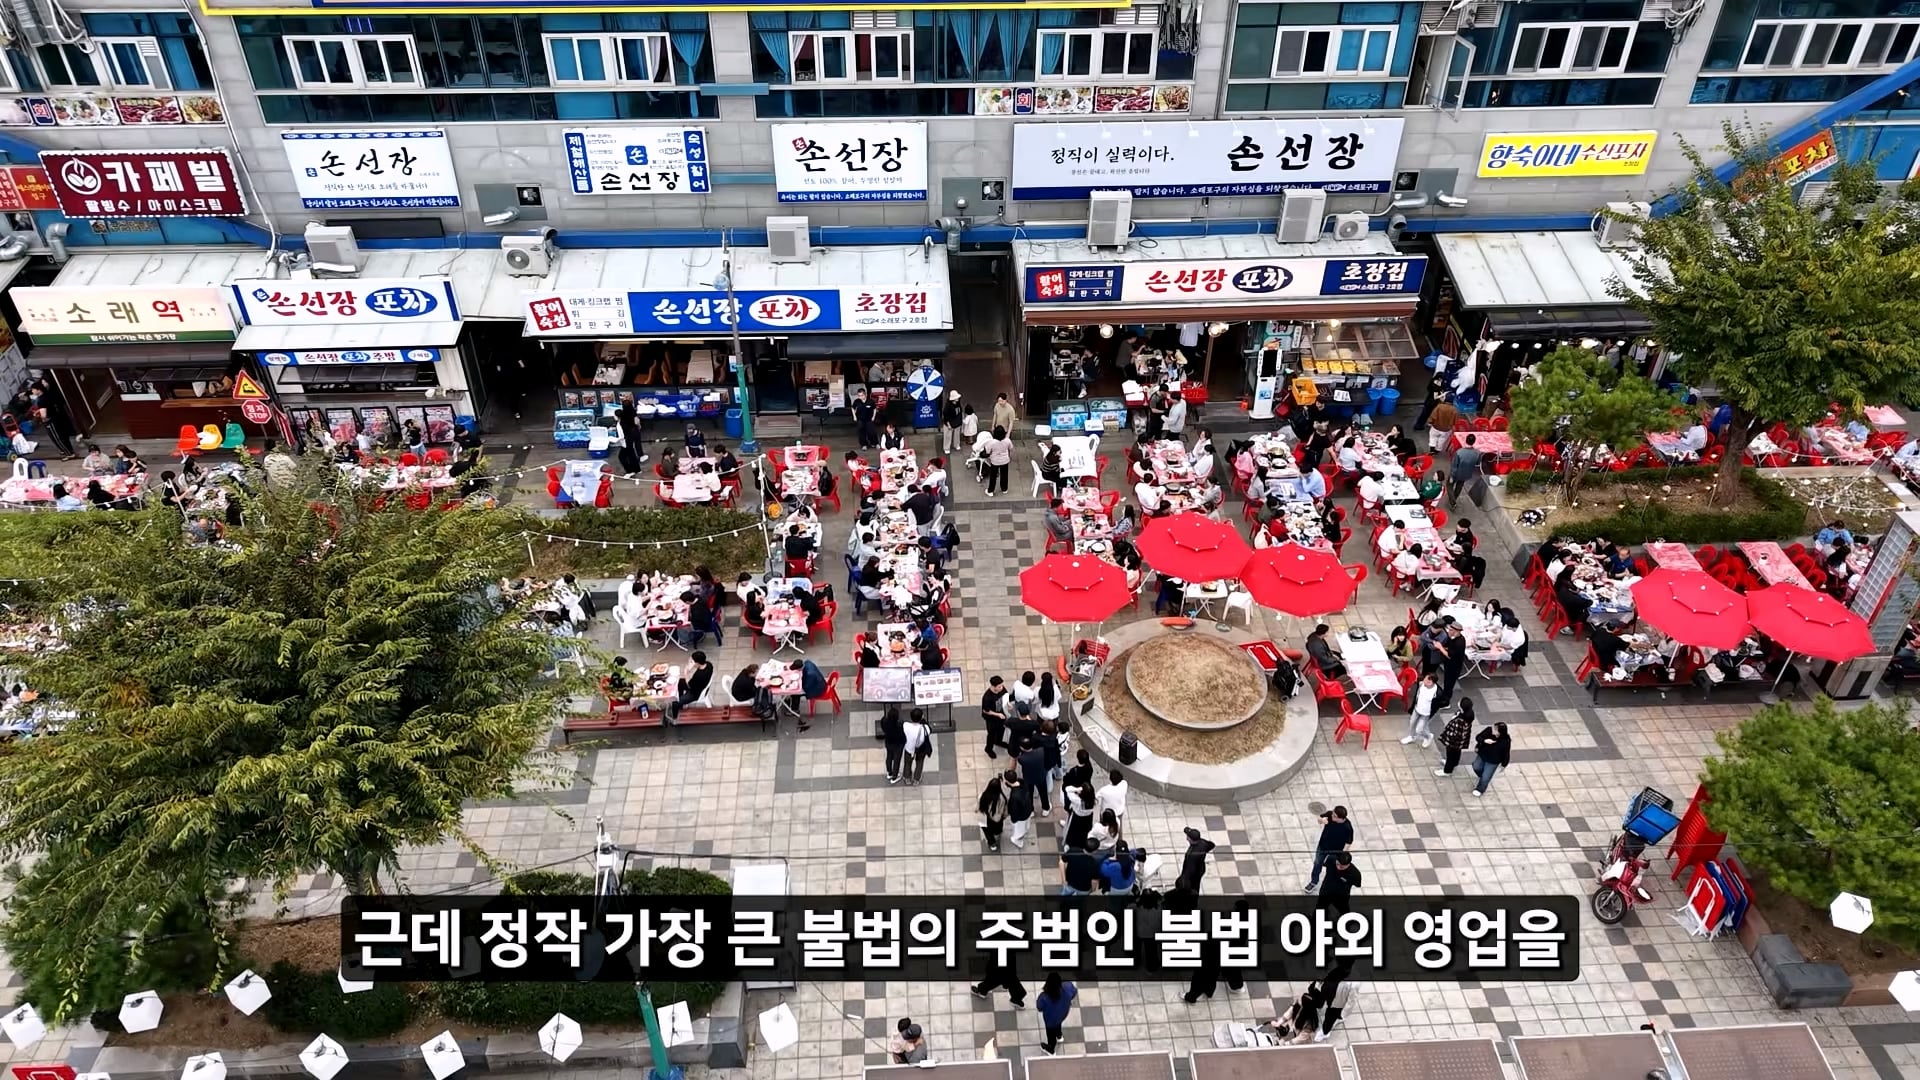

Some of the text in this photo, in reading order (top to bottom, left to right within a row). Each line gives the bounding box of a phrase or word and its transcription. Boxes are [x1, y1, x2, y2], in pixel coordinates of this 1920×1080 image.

[33, 103, 49, 118] 회
[1018, 92, 1031, 109] 회
[629, 147, 644, 163] 손
[687, 133, 702, 159] 숙성
[795, 137, 909, 172] 손선장
[1051, 145, 1175, 164] 정직이 실력이다.
[1227, 133, 1364, 172] 손선장
[1487, 143, 1648, 169] 향숙이네 수산포차
[320, 147, 417, 176] 손선장
[569, 135, 589, 191] 제철해산물
[102, 160, 227, 193] 카페빌
[600, 171, 680, 191] 손선장
[690, 164, 705, 190] 활어
[1134, 188, 1150, 196] 팔지
[1152, 186, 1187, 196] 않습니다.
[1189, 185, 1229, 194] 소래포구의
[1231, 184, 1263, 193] 자부심을
[84, 200, 131, 213] 팔빙수
[147, 198, 223, 211] 아이스크림
[1040, 271, 1063, 285] 활어
[1145, 268, 1288, 293] 손선장 포차
[1341, 262, 1408, 282] 초장집
[1041, 283, 1063, 297] 숙성
[66, 300, 184, 324] 소래역
[268, 289, 430, 316] 손선장 포차
[533, 301, 562, 316] 활어
[652, 297, 813, 326] 손선장 포차
[854, 292, 927, 314] 초장집
[538, 314, 568, 330] 숙성
[304, 354, 339, 363] 손선장
[373, 351, 396, 361] 주방
[248, 412, 268, 420] STOP
